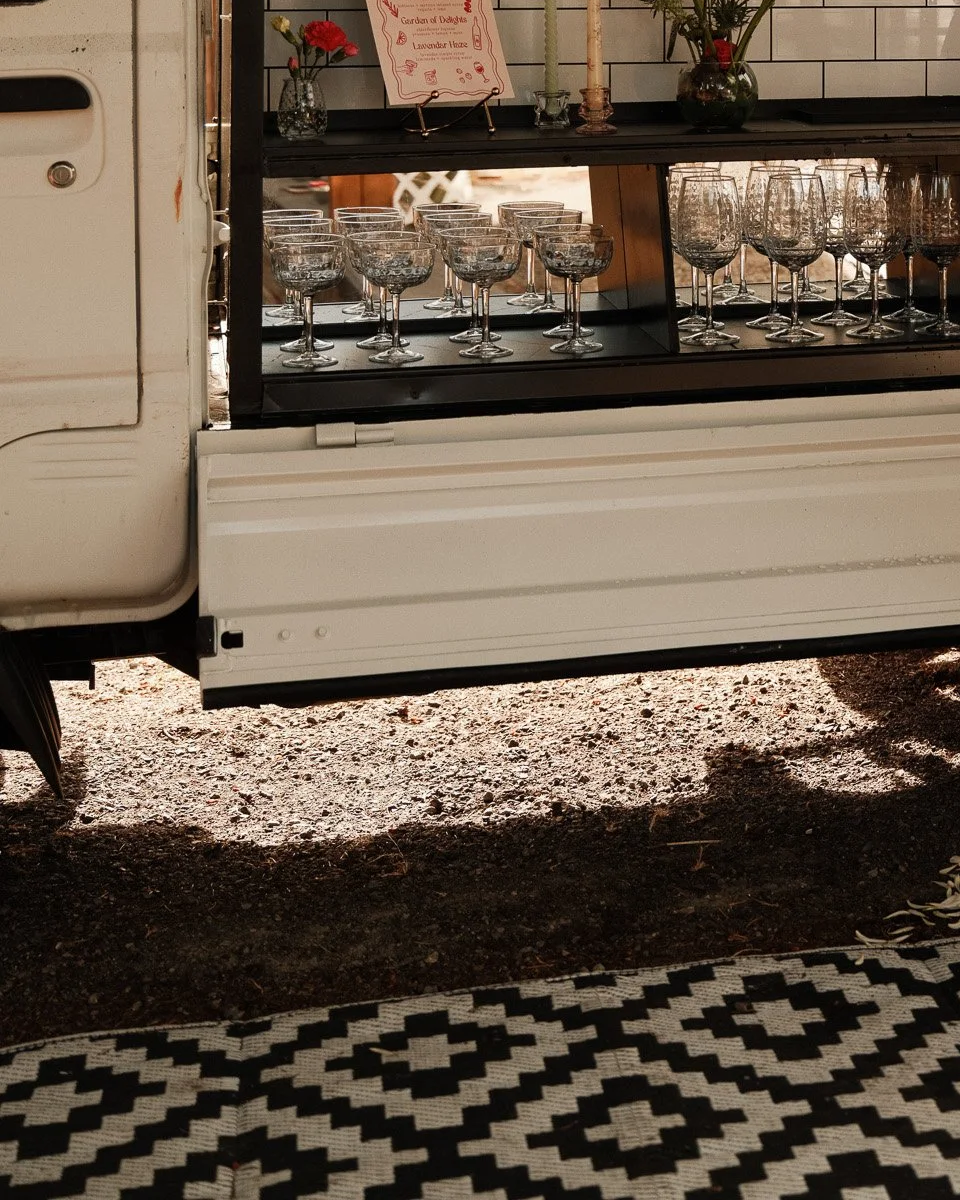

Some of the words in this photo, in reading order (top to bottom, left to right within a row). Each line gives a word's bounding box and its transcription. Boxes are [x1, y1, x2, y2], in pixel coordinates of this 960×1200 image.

[400, 16, 428, 25] Garden
[429, 15, 438, 24] of
[439, 16, 468, 25] Delights
[449, 40, 468, 49] Haze
